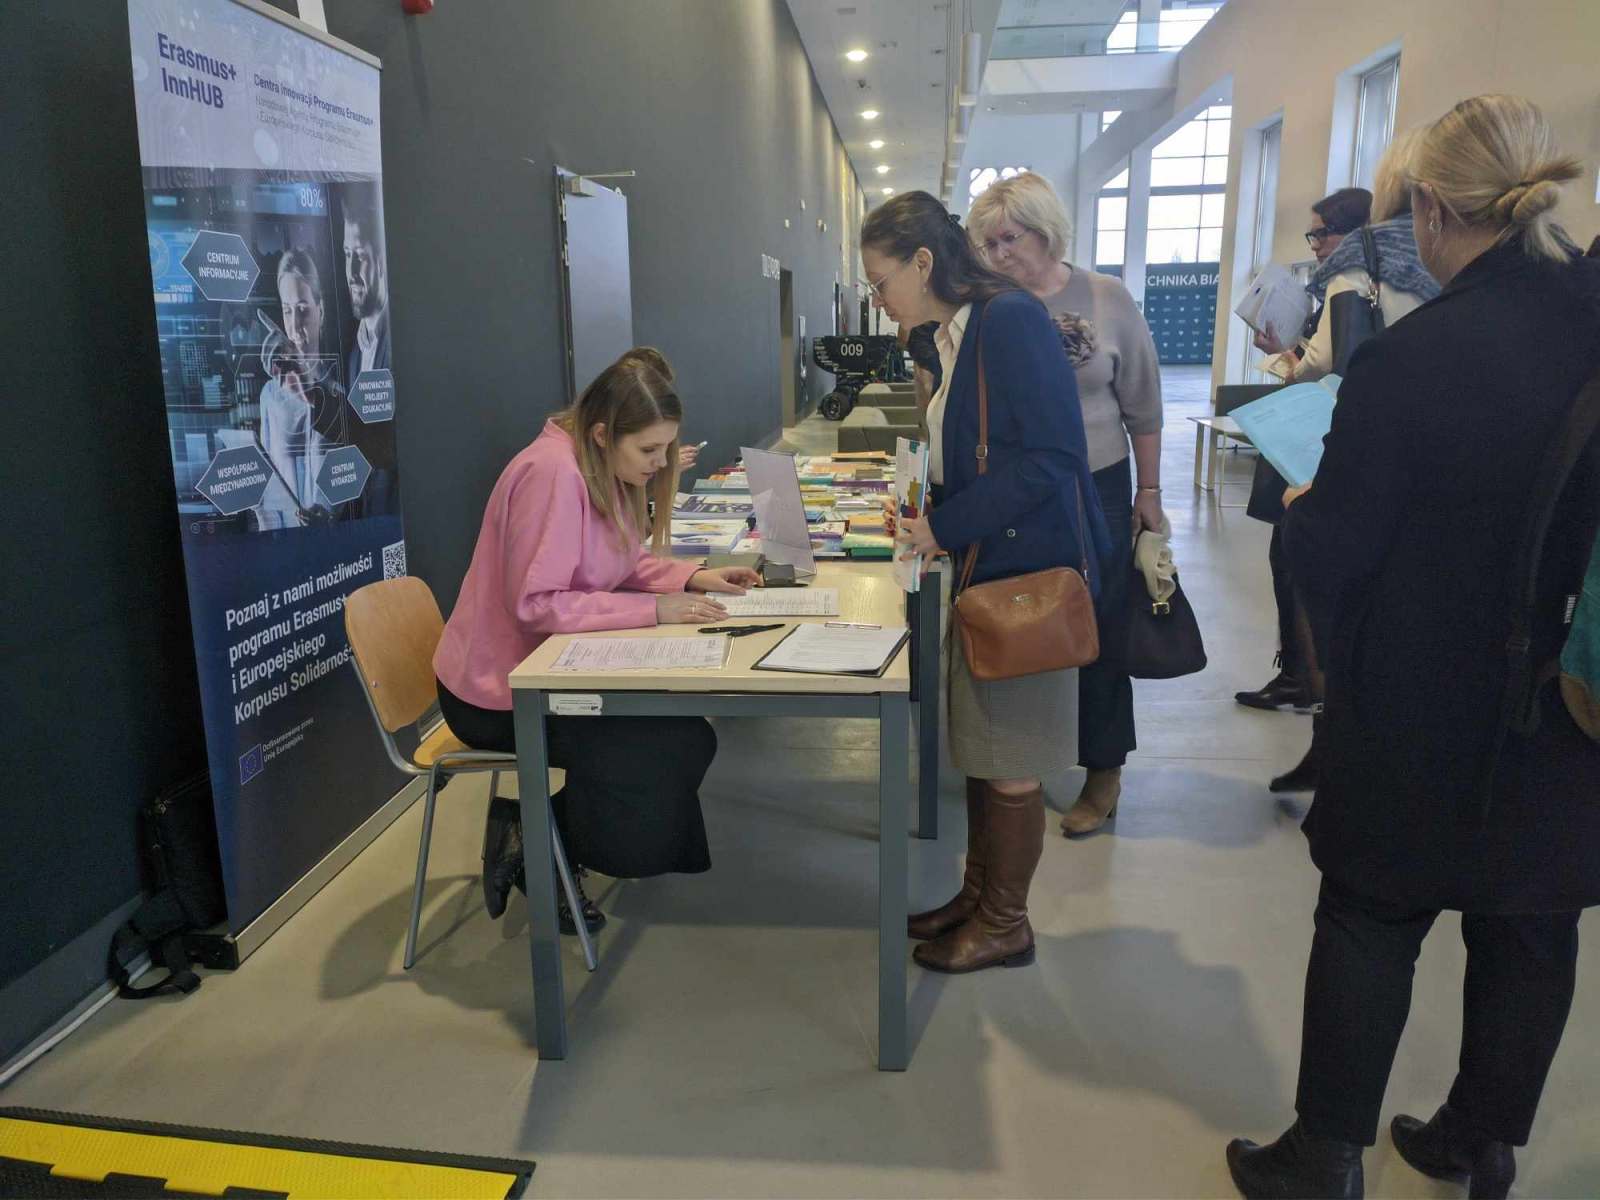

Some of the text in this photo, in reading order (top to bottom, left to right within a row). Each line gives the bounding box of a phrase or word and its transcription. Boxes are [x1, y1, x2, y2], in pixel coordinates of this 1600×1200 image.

[158, 32, 236, 80] Erasmus+
[161, 67, 224, 109] InnHUB
[253, 73, 280, 93] Centra
[300, 188, 323, 208] 80%
[198, 266, 249, 281] INFORMACYJNE
[206, 251, 240, 265] CENTRUM
[840, 343, 864, 357] 009
[331, 462, 355, 474] CENTRUM
[225, 552, 373, 631] Poznaj z nami możliwości
[229, 619, 291, 668] programu
[231, 633, 326, 694] i Europejskiego
[234, 681, 288, 725] Korpusu
